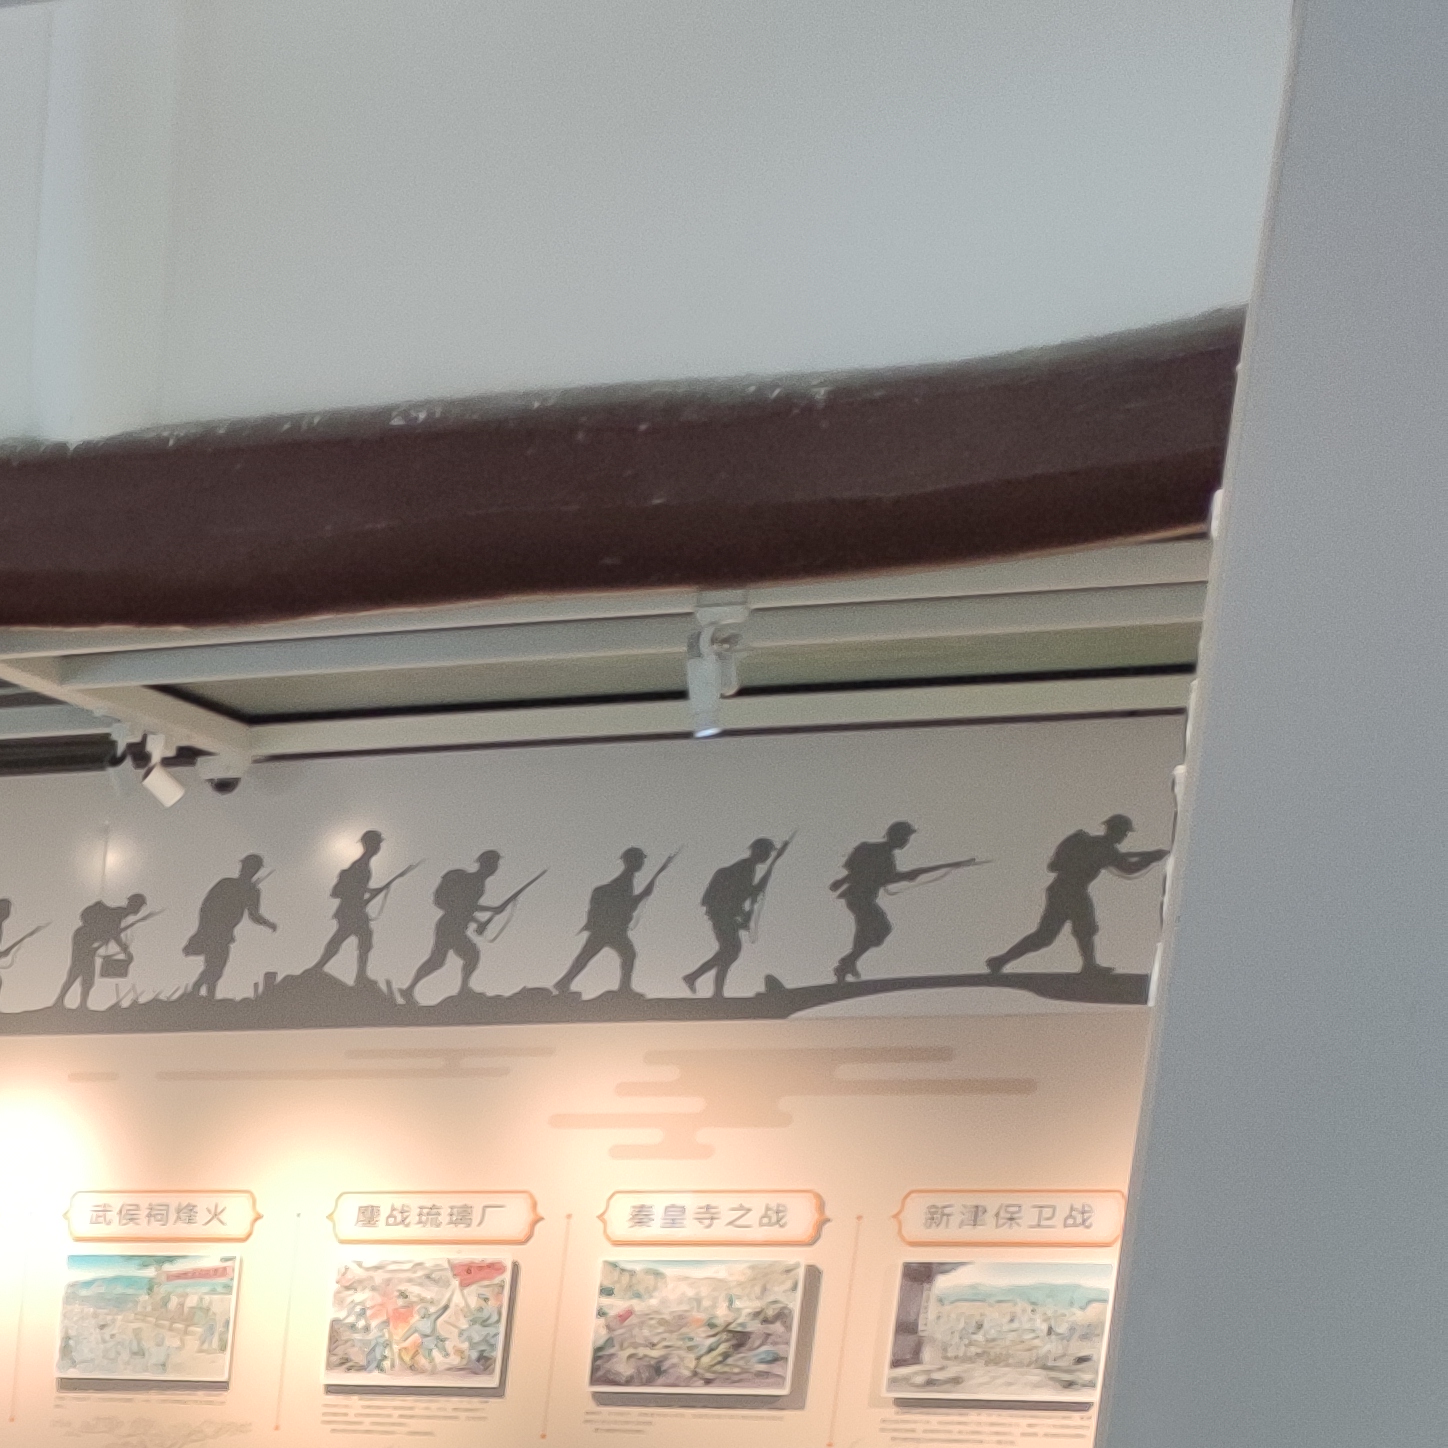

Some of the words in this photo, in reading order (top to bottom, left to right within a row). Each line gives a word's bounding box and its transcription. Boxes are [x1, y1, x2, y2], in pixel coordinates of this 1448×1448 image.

[89, 1202, 228, 1227] 武侯祠烽火
[354, 1203, 507, 1228] 鏖战琉璃厂
[627, 1203, 789, 1229] 秦皇寺之战
[923, 1202, 1096, 1230] 新津保卫战
